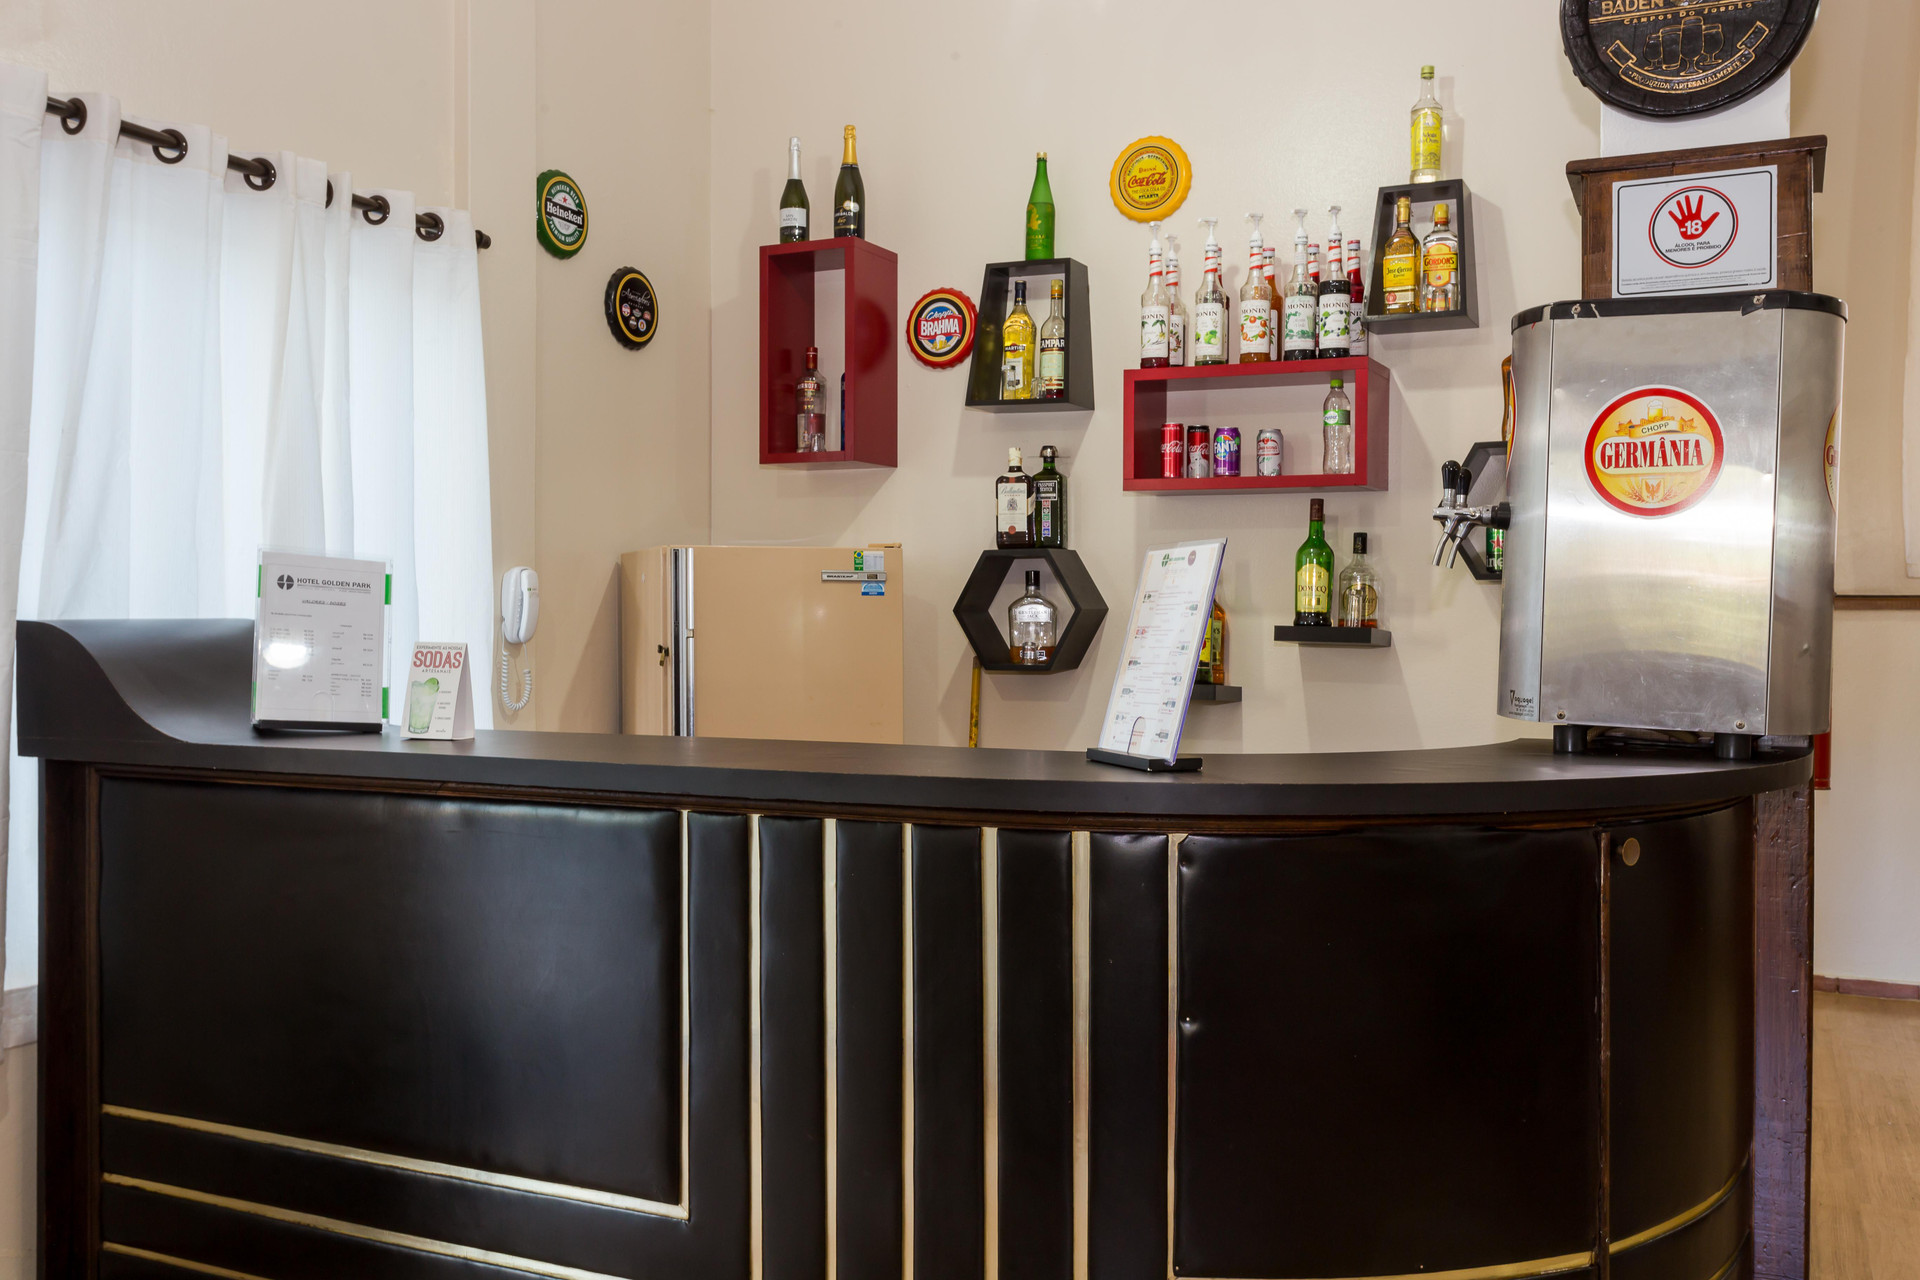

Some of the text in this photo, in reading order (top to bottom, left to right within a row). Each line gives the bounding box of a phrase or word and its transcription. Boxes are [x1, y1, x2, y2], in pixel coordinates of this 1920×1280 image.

[1623, 13, 1672, 25] CAMPOS
[1630, 61, 1742, 90] PRODUZIDA ARTESANALMENTE
[546, 200, 583, 225] Heineken
[1680, 219, 1703, 236] -18
[1665, 246, 1691, 254] MENORES
[1286, 302, 1313, 310] MONIN
[1322, 301, 1350, 310] MONIN
[920, 318, 959, 336] BRAHMA
[1641, 421, 1669, 434] CHOPP
[1214, 441, 1238, 453] FANTA
[1600, 437, 1704, 469] GERMÂNIA
[297, 577, 319, 585] HOTEL
[320, 580, 350, 588] GOLDEN
[413, 650, 463, 669] SODAS
